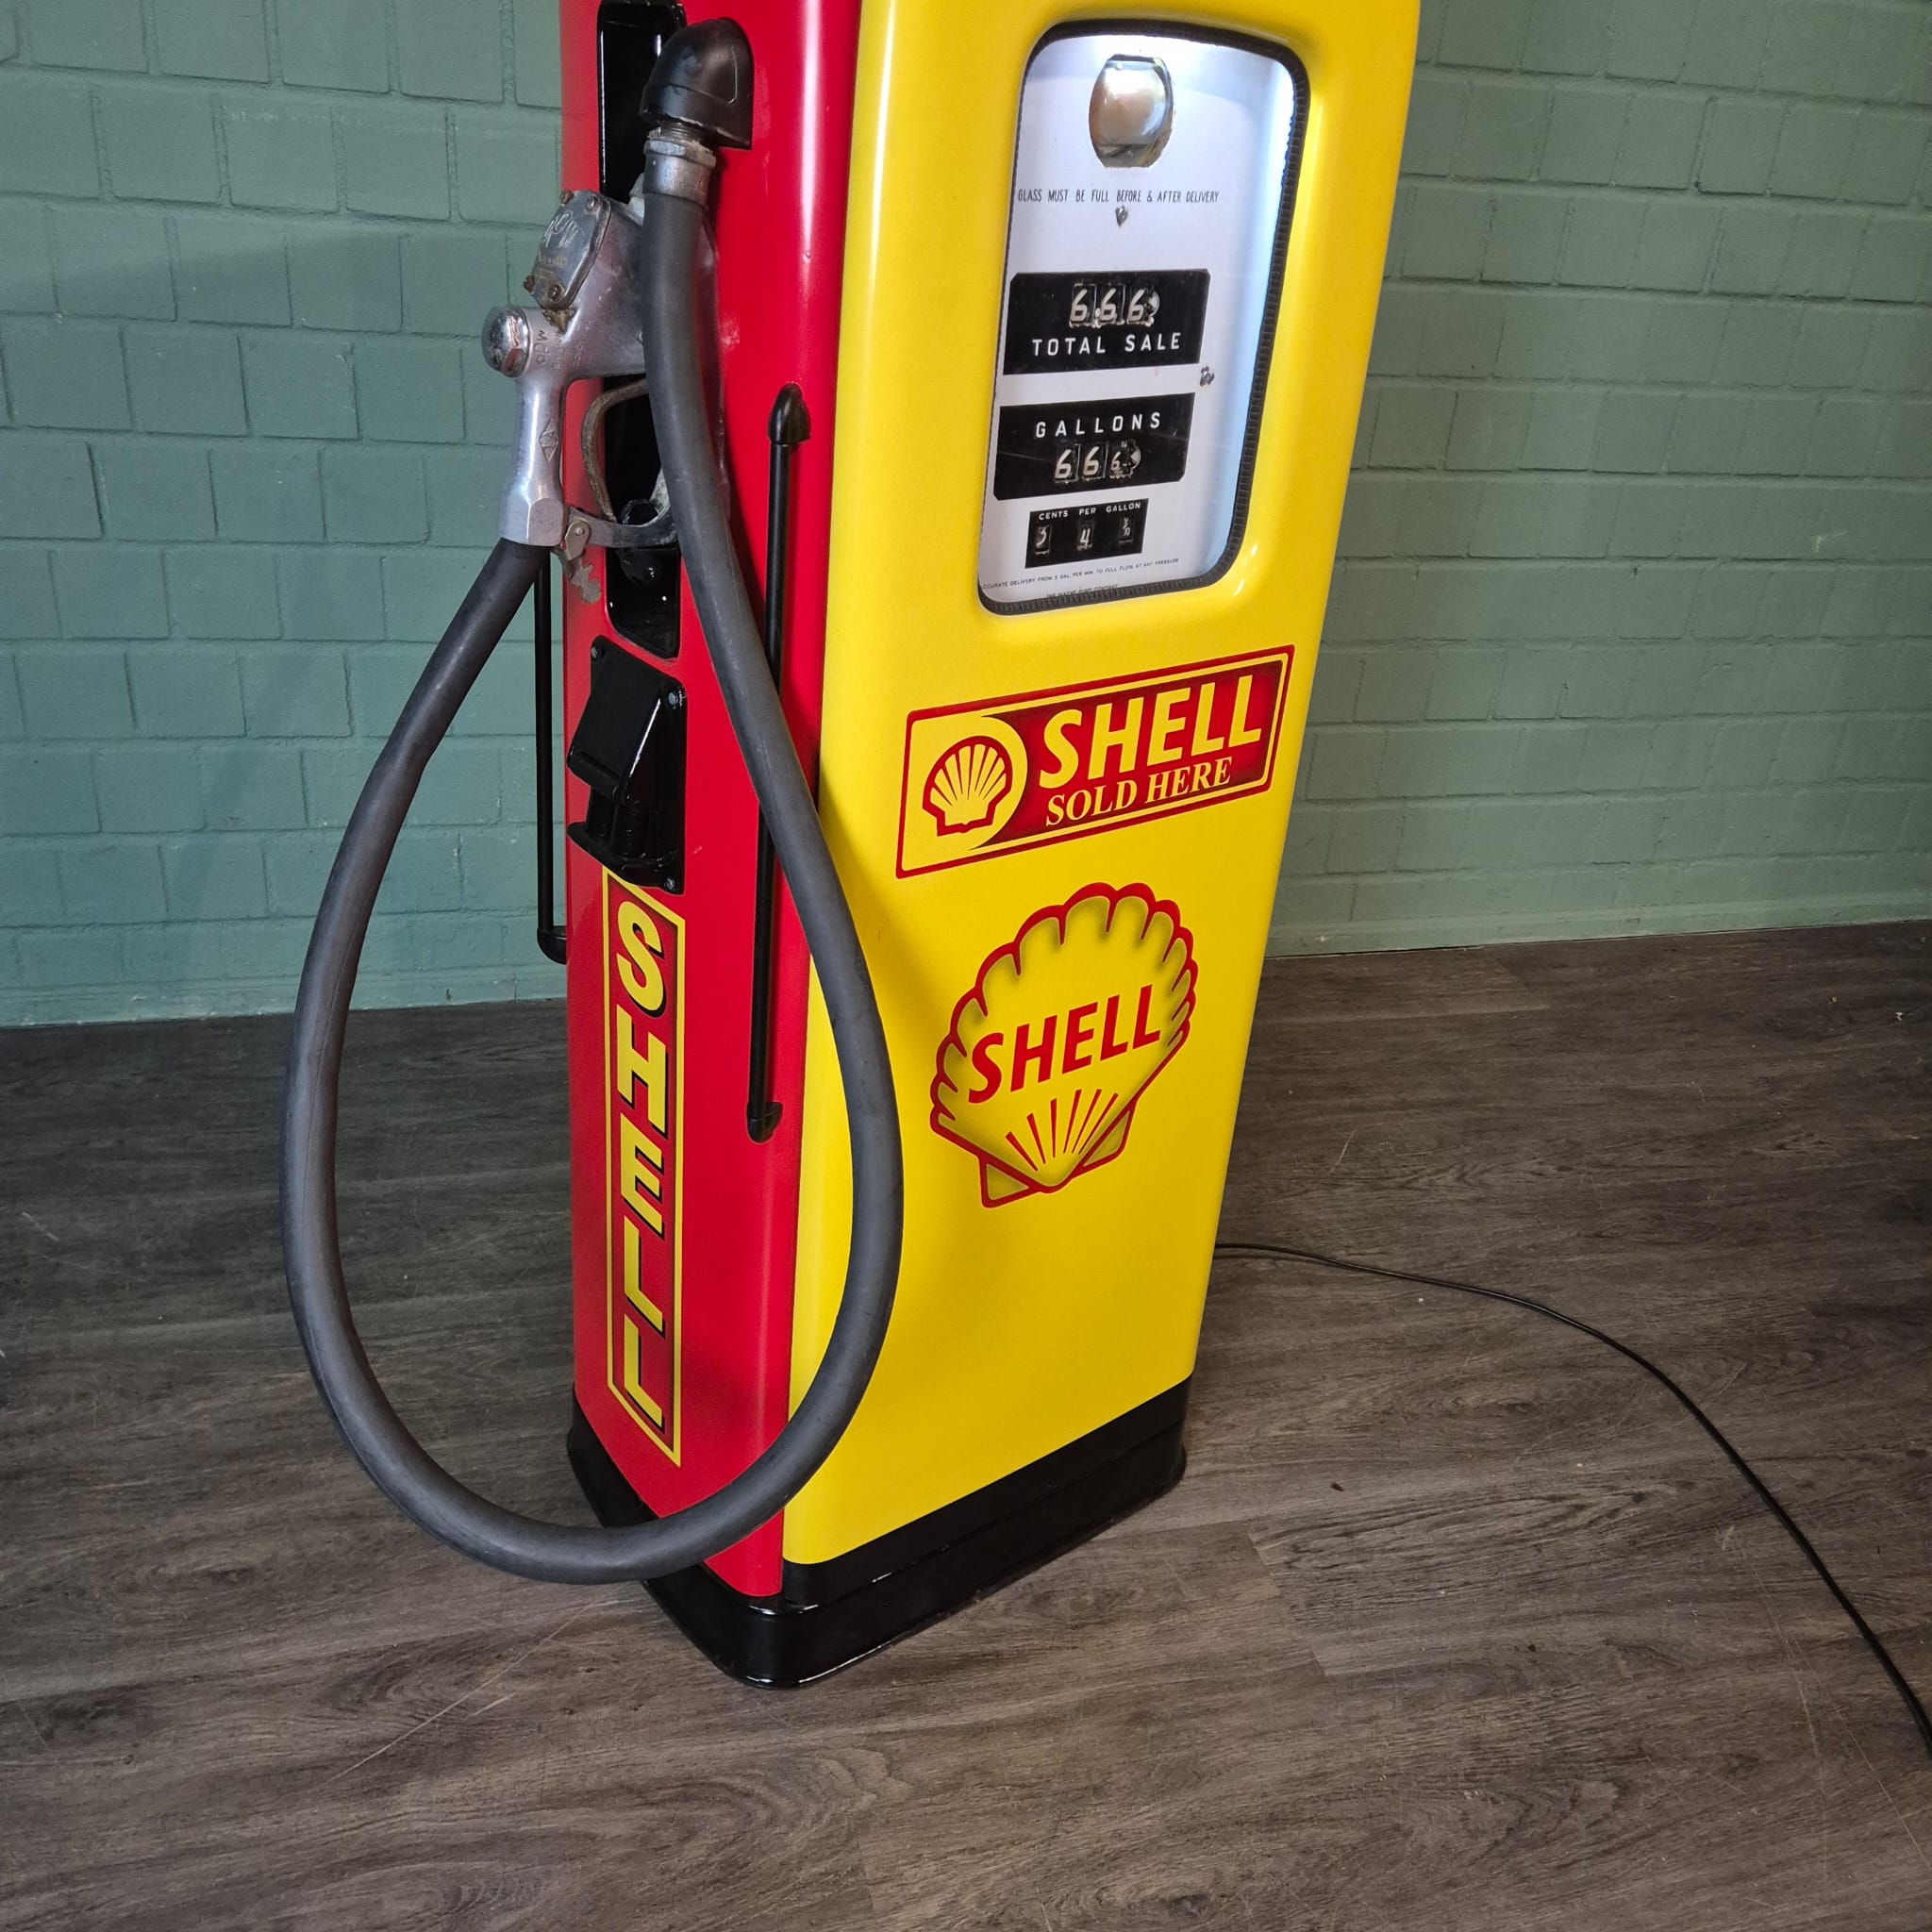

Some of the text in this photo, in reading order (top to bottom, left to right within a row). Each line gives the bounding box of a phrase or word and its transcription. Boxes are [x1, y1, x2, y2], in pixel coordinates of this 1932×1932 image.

[1018, 189, 1220, 203] GLASS MUST BE FULL BEFORE & AFTER DELIVERY
[1032, 332, 1181, 357] TOTAL SALE
[1035, 411, 1161, 439] GALLONS
[1039, 502, 1141, 521] CENTS PER GALLON
[979, 580, 1008, 590] CCURATE
[1010, 577, 1036, 586] DELIVERY
[1039, 675, 1262, 789] SHELL
[1045, 756, 1233, 827] SOLD HERE
[968, 984, 1161, 1105] SHELL
[616, 900, 666, 1431] SHELL
